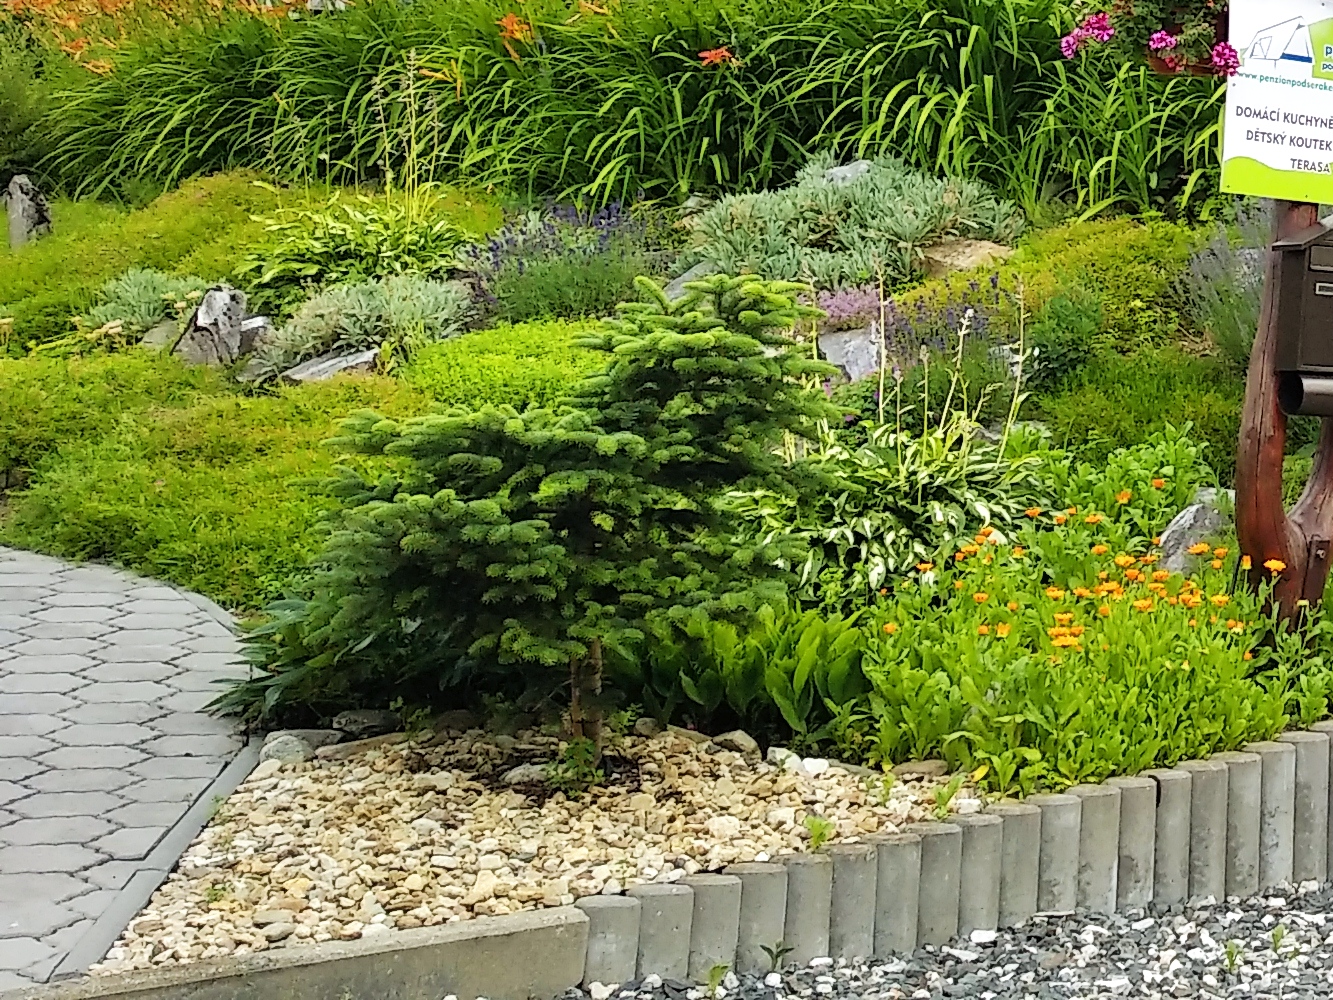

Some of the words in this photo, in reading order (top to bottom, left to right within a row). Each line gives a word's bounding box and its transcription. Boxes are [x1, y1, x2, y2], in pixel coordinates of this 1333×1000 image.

[1235, 106, 1280, 122] DOMÁCÍ
[1283, 111, 1333, 129] KUCHYNĚ
[1246, 127, 1287, 145] DĚTSKÝ
[1289, 135, 1333, 152] KOUTEK
[1290, 158, 1330, 173] TERASA
